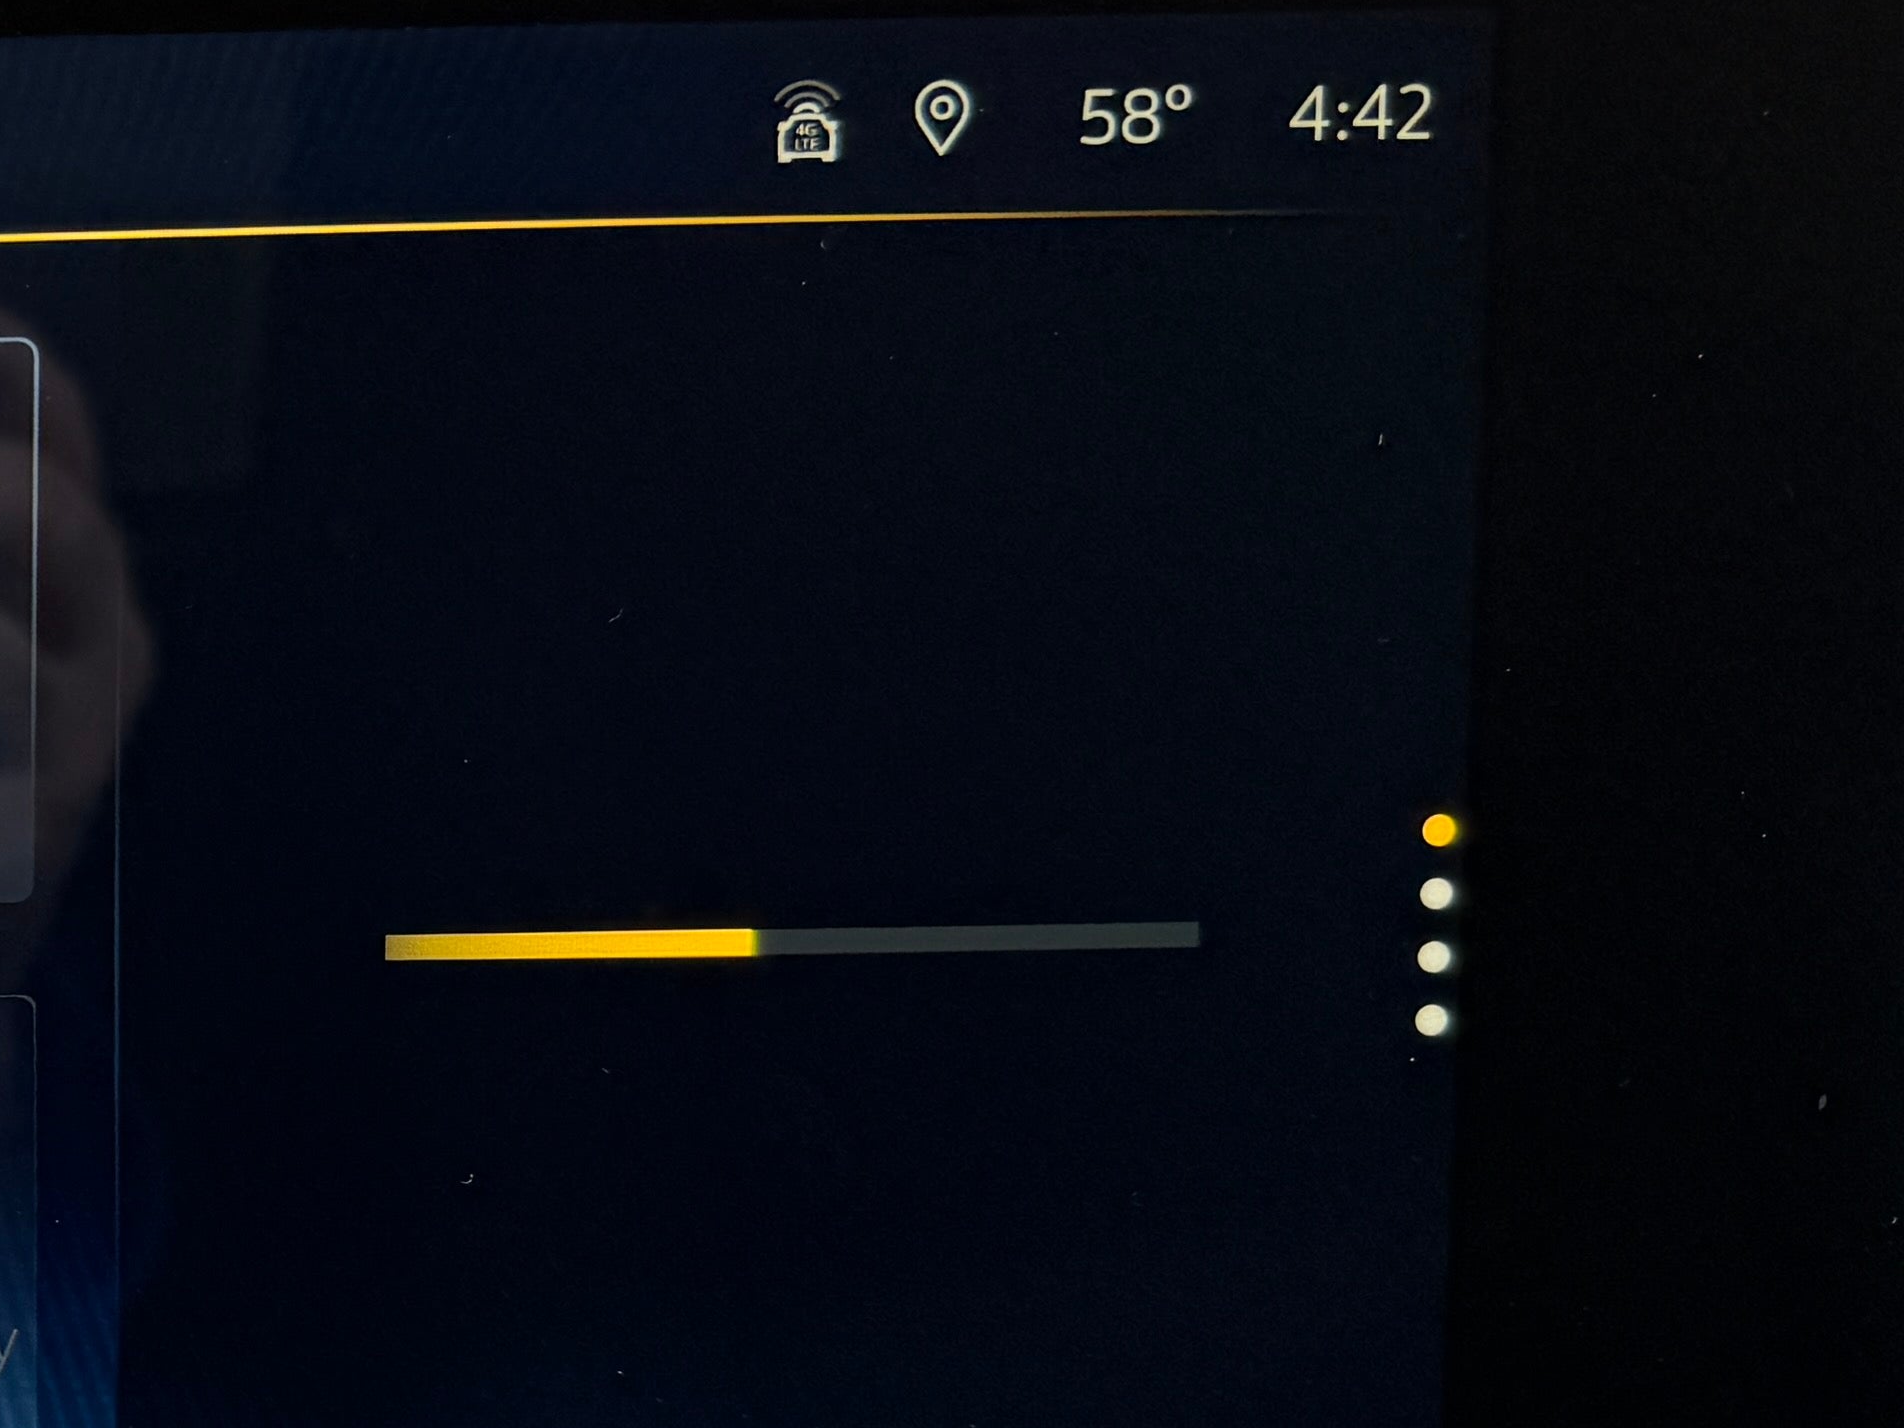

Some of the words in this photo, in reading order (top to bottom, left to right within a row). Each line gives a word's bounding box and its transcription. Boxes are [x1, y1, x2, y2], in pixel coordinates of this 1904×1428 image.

[1288, 82, 1434, 142] 4:42
[795, 123, 819, 137] 4G
[794, 138, 820, 151] LTE
